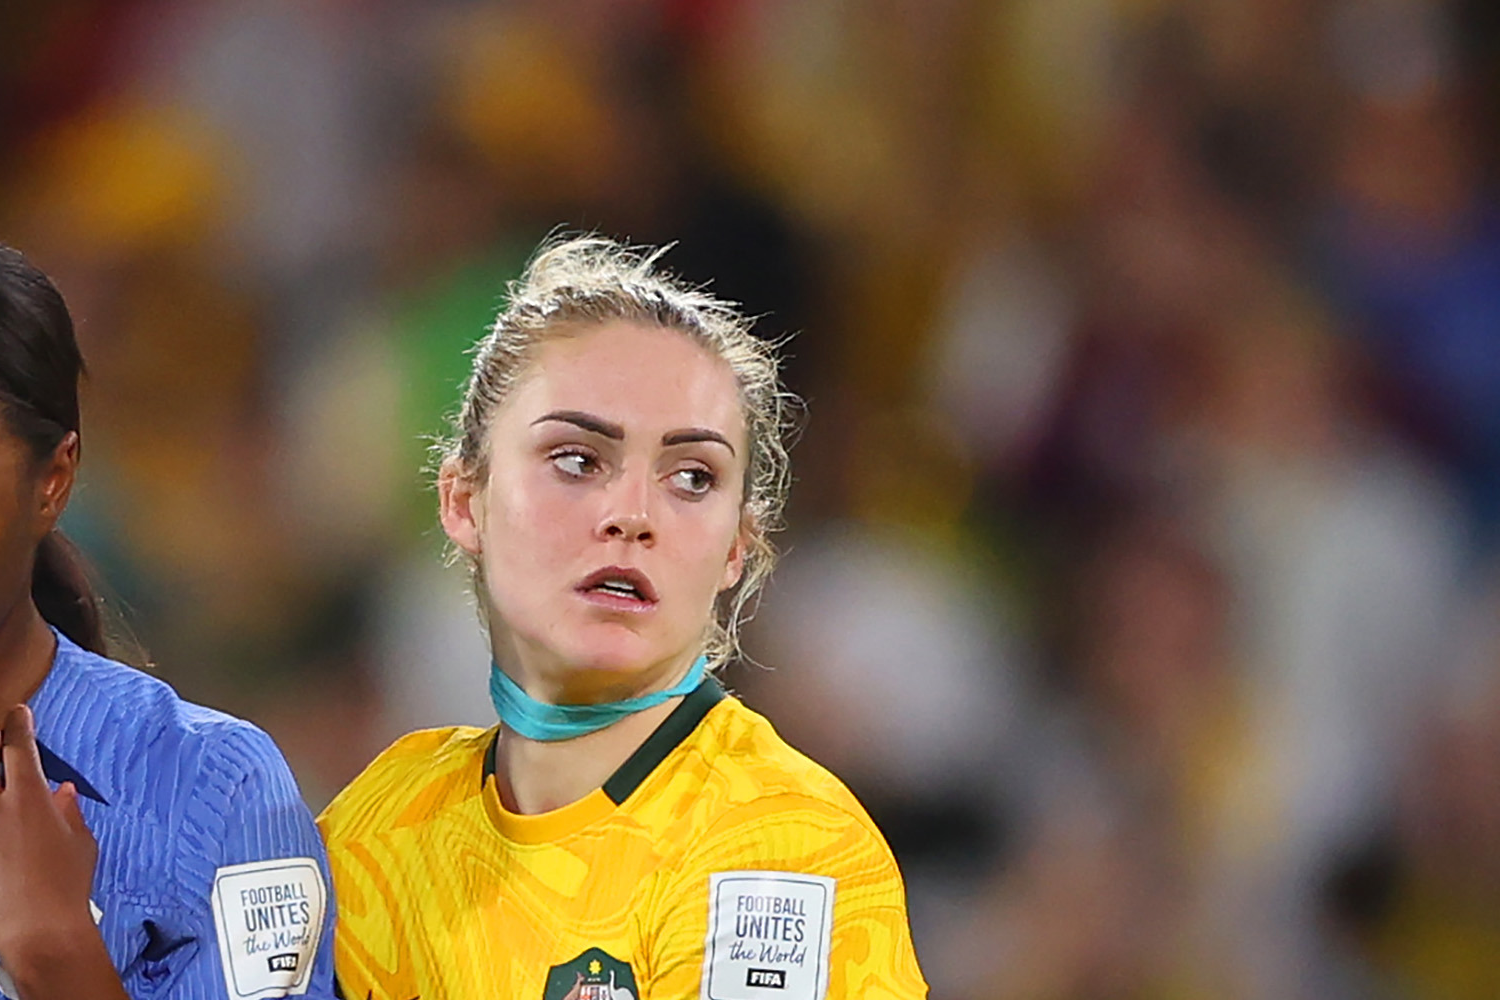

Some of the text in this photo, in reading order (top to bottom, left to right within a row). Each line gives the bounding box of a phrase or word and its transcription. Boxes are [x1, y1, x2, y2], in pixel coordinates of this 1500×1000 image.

[240, 883, 308, 907] FOOTBALL
[736, 895, 806, 917] FOOTBALL
[244, 901, 309, 932] UNITES
[735, 915, 806, 942] UNITES
[243, 934, 271, 956] the
[729, 940, 808, 967] the World
[750, 971, 782, 986] FIFA
